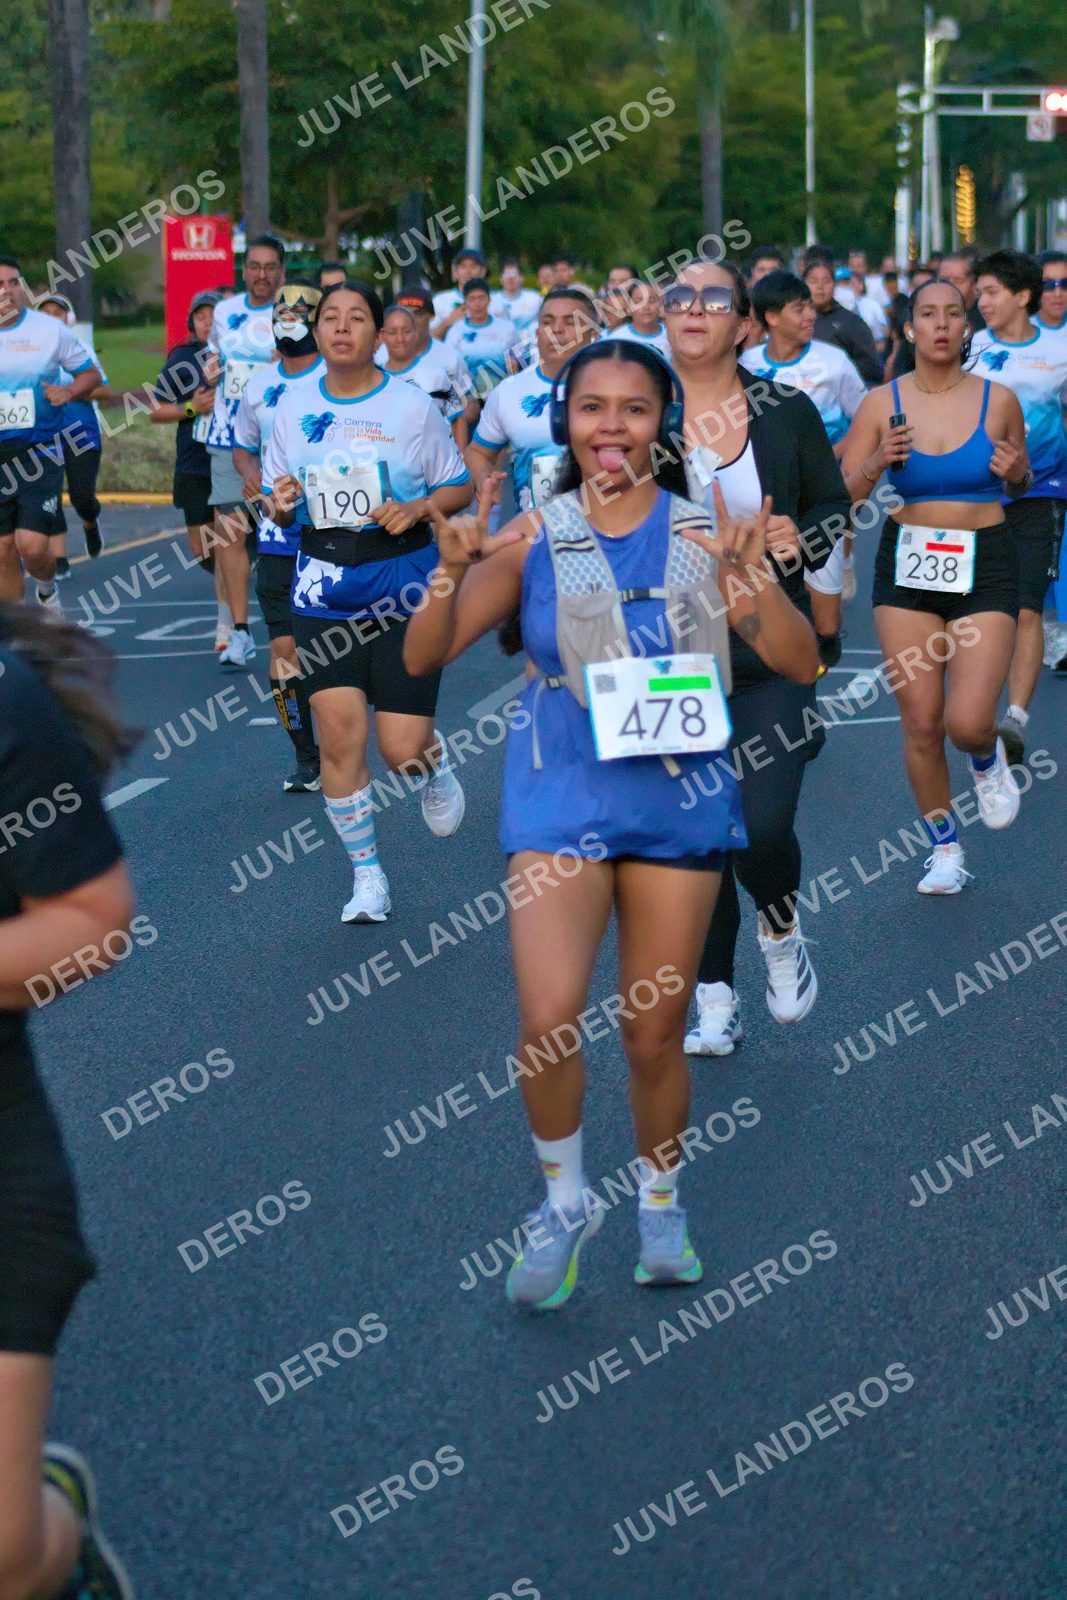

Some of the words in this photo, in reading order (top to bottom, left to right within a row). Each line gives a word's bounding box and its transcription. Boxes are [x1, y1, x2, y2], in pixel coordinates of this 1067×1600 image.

[171, 248, 226, 261] HONDA
[344, 417, 382, 428] Carrera
[356, 433, 395, 443] Integridad
[317, 489, 371, 519] 190
[905, 552, 958, 583] 238
[618, 695, 706, 741] 478
